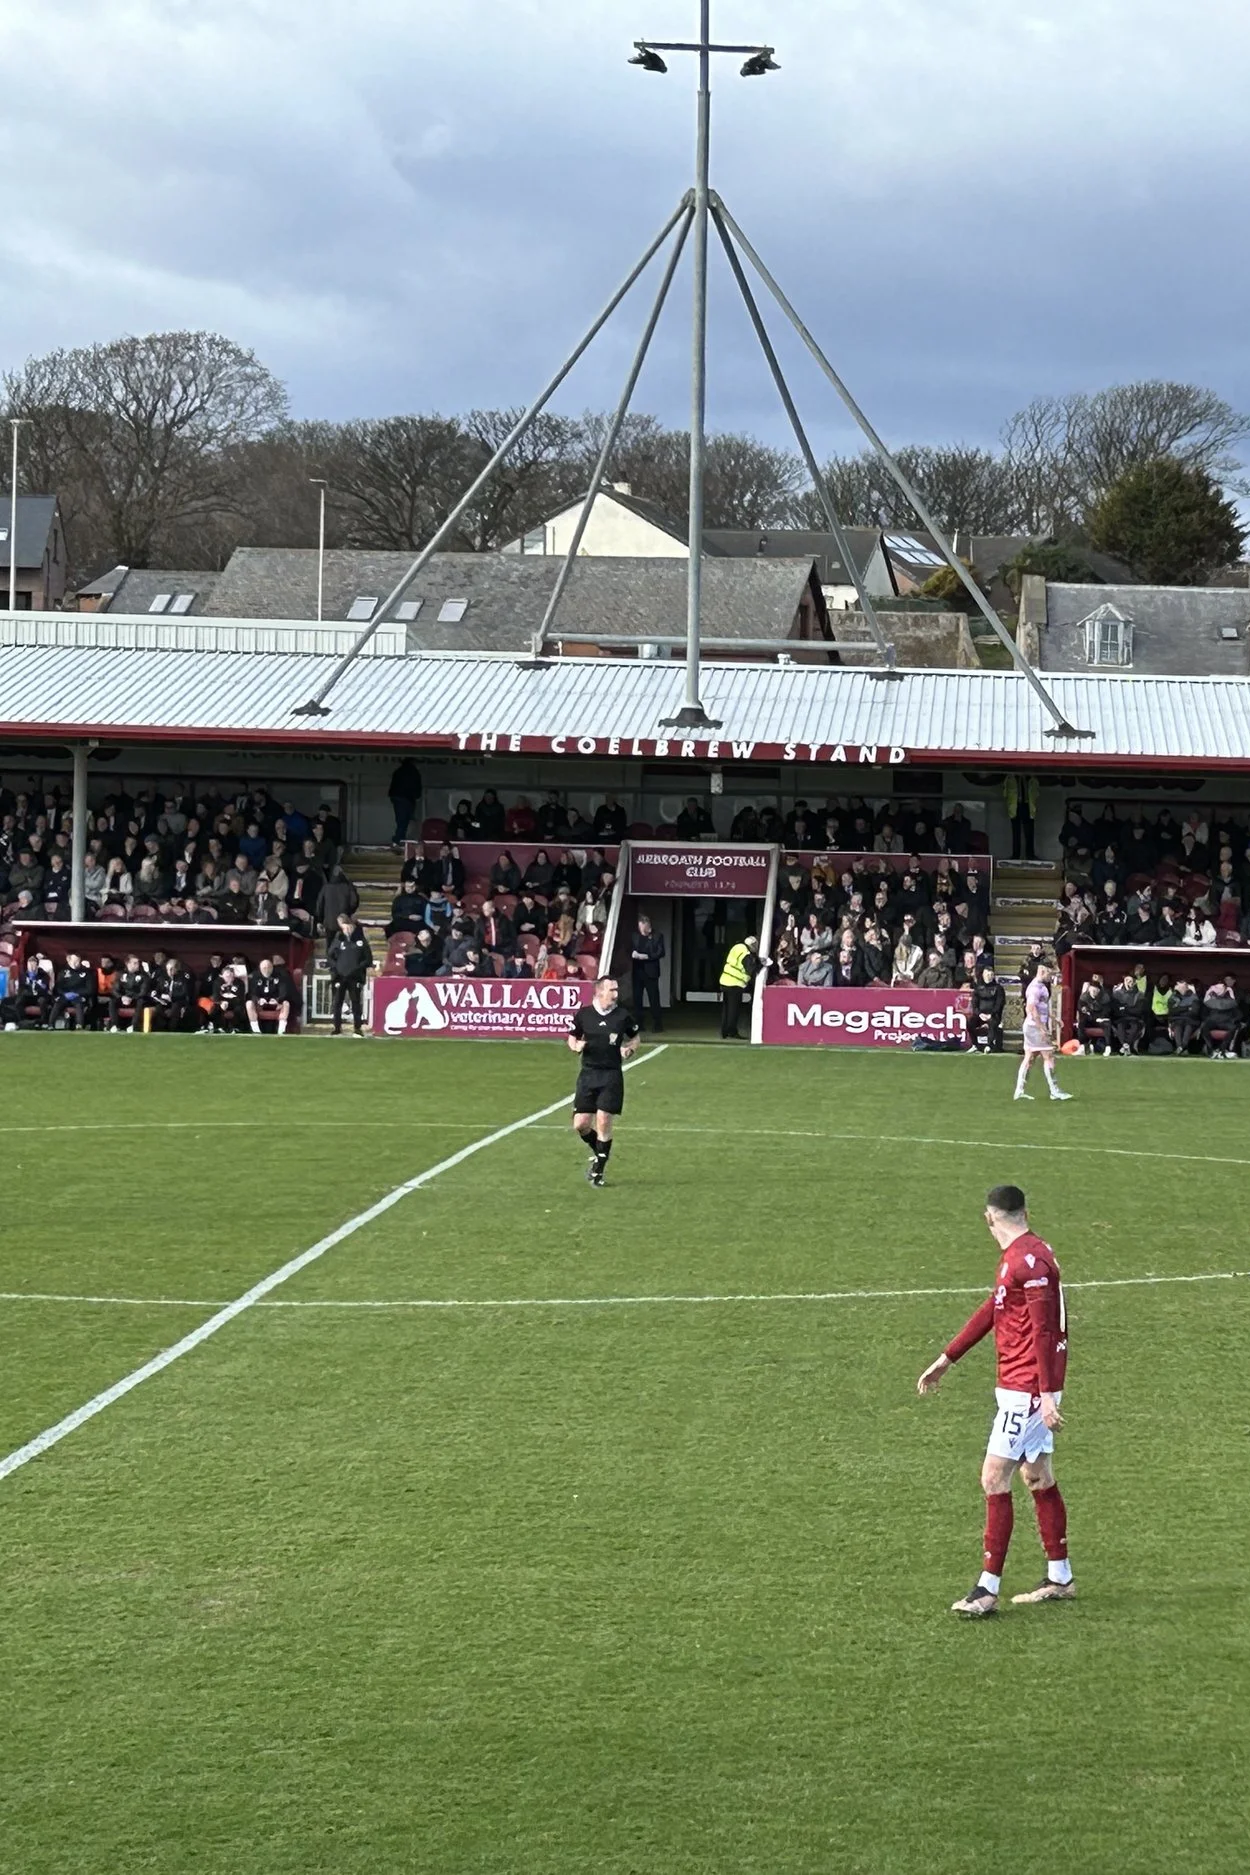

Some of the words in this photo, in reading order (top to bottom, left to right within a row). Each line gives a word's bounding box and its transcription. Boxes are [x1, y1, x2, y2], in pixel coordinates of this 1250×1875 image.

[456, 733, 522, 752] THE
[551, 736, 755, 759] COELBREW
[783, 743, 906, 765] STAND
[636, 854, 702, 866] ARBROATH
[705, 855, 767, 868] FOOTBALL
[685, 866, 716, 878] CLUB
[434, 982, 582, 1010] WALLACE
[450, 1010, 525, 1026] veterinary
[787, 1003, 967, 1034] MegaTech
[1002, 1410, 1023, 1436] 15
